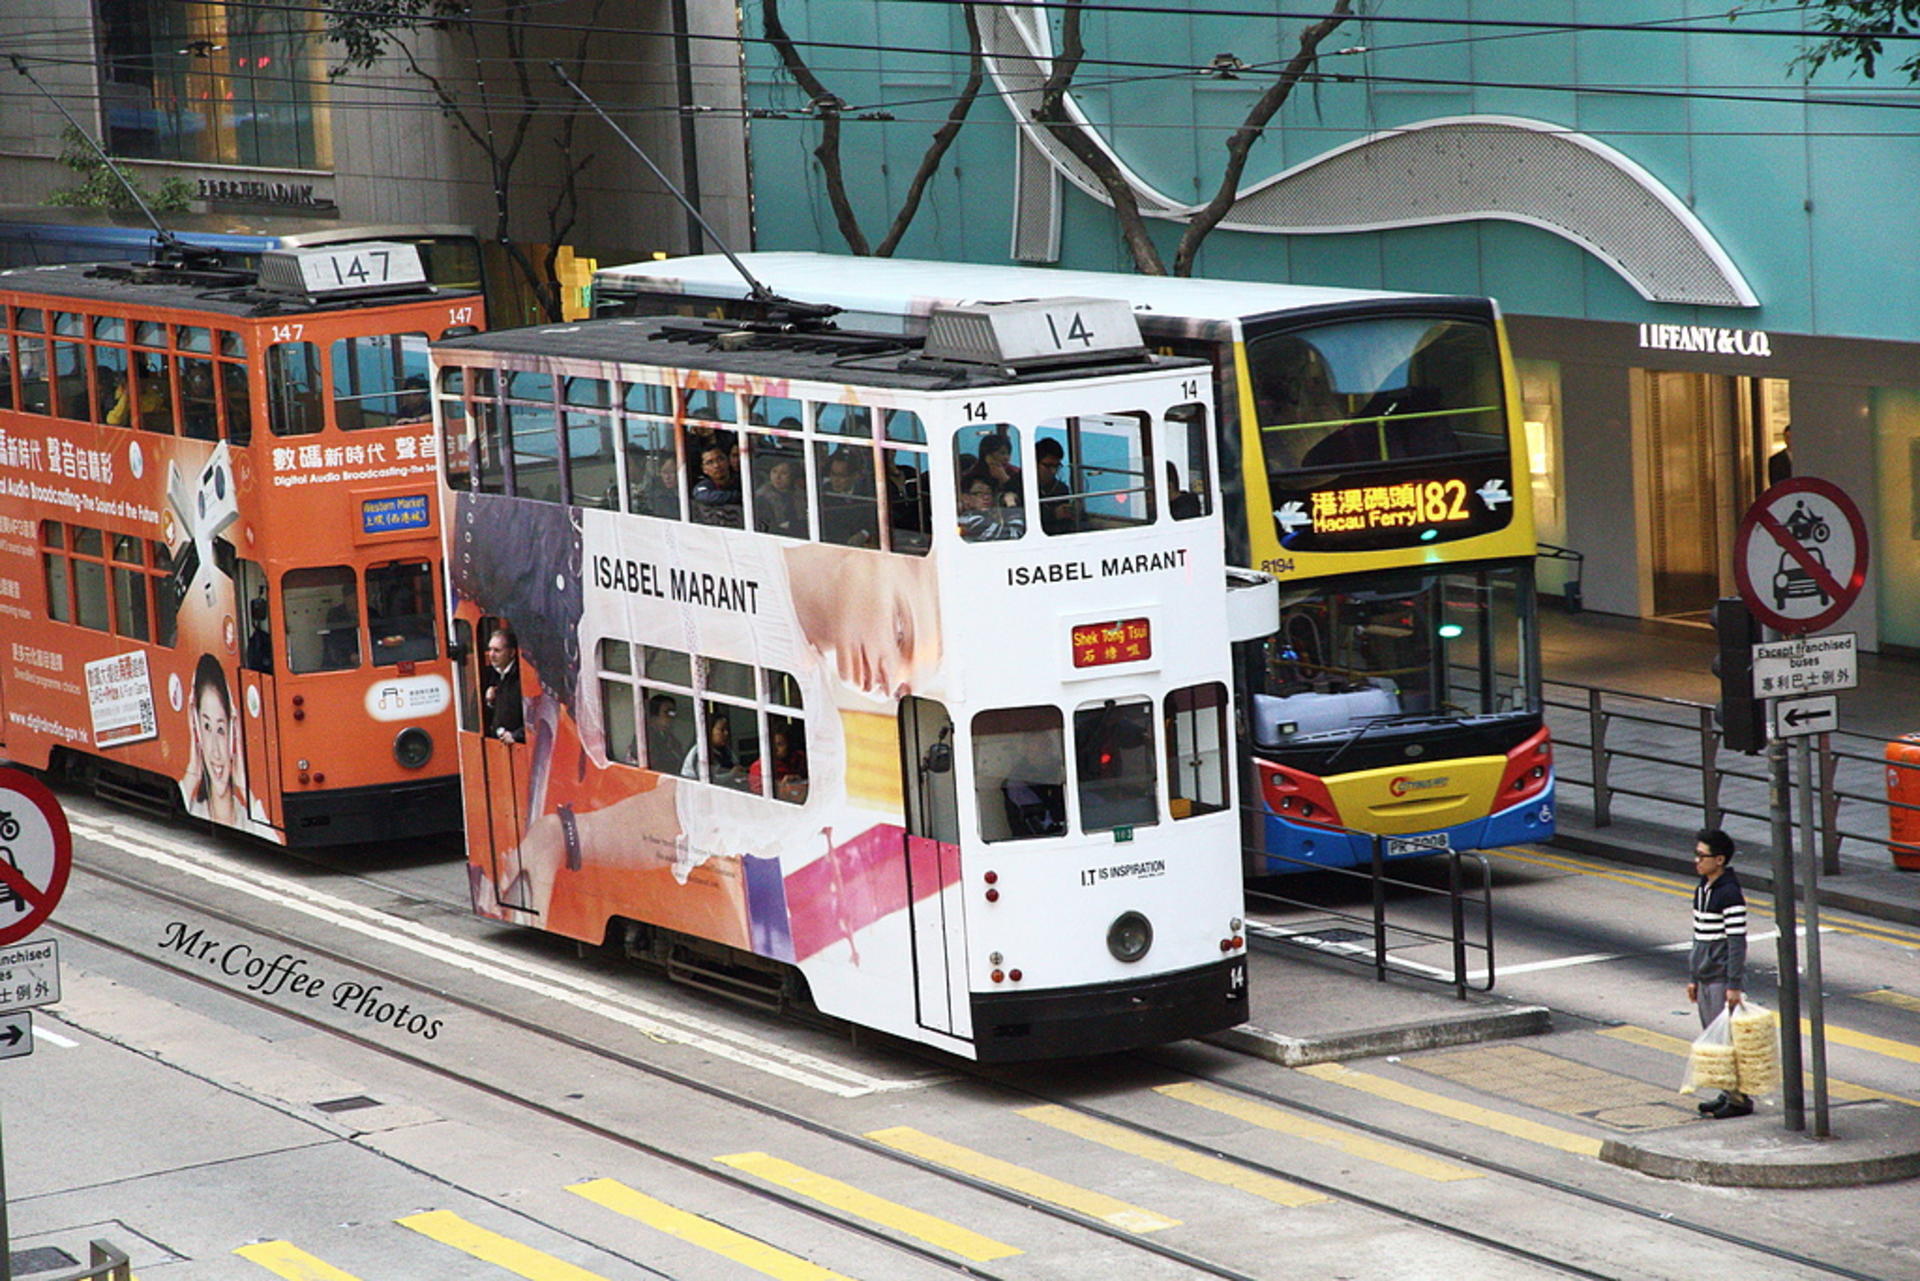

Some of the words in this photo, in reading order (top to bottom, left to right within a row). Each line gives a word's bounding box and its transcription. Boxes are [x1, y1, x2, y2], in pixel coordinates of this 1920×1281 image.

[331, 251, 389, 286] 147
[449, 307, 473, 325] 147
[271, 323, 304, 342] 147
[1045, 312, 1094, 350] 14
[1181, 380, 1198, 399] 14
[962, 401, 988, 422] 14
[271, 442, 386, 472] 數碼新時代
[273, 472, 308, 487] Digital
[309, 471, 340, 485] Audio
[1310, 484, 1417, 517] 港澳碼頭
[1416, 479, 1470, 523] 182
[1313, 515, 1366, 534] Macau
[1369, 509, 1417, 528] Ferry
[1008, 561, 1093, 586] ISABEL
[1101, 549, 1188, 578] MARANT
[1261, 558, 1294, 574] 8194
[593, 554, 665, 598] ISABEL
[670, 567, 759, 614] MARANT
[1073, 630, 1099, 647] Shek
[1757, 645, 1794, 659] Except
[1795, 638, 1852, 657] franchised
[1789, 657, 1820, 669] buses
[1110, 859, 1165, 878] INSPIRATION
[1231, 965, 1244, 989] 14
